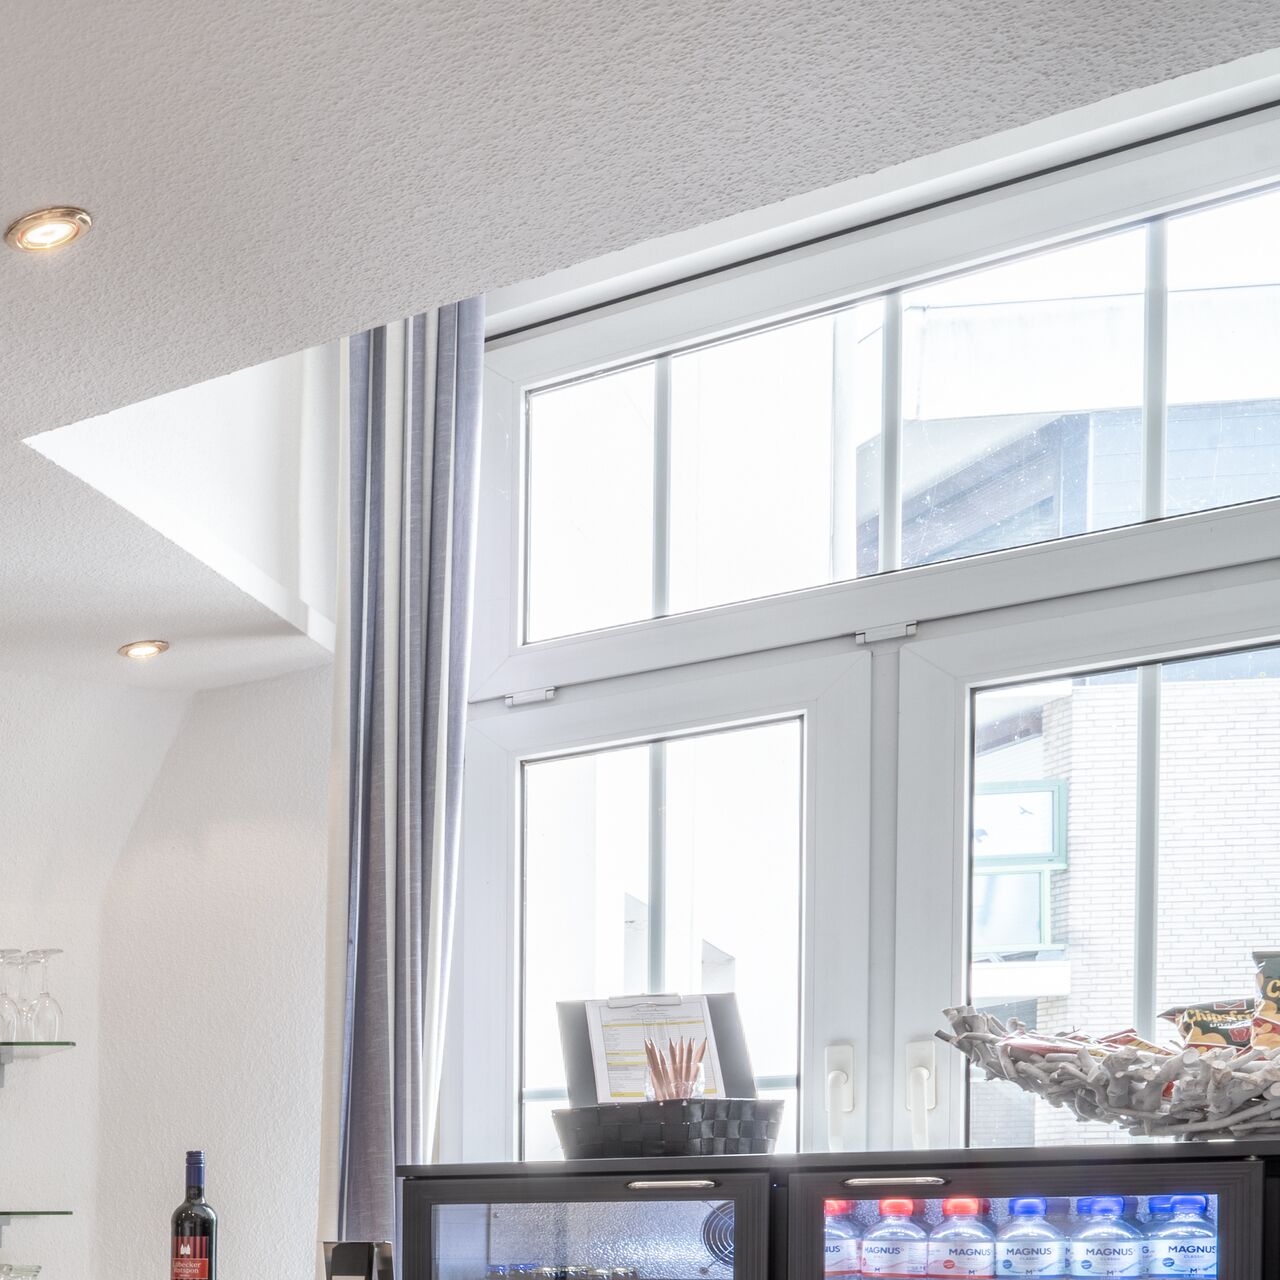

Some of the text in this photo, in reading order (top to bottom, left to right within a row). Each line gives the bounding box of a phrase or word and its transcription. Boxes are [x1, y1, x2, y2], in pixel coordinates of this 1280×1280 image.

[948, 1248, 991, 1256] MAGNUS
[1006, 1247, 1052, 1256] MAGNUS
[1086, 1248, 1134, 1256] MAGNUS
